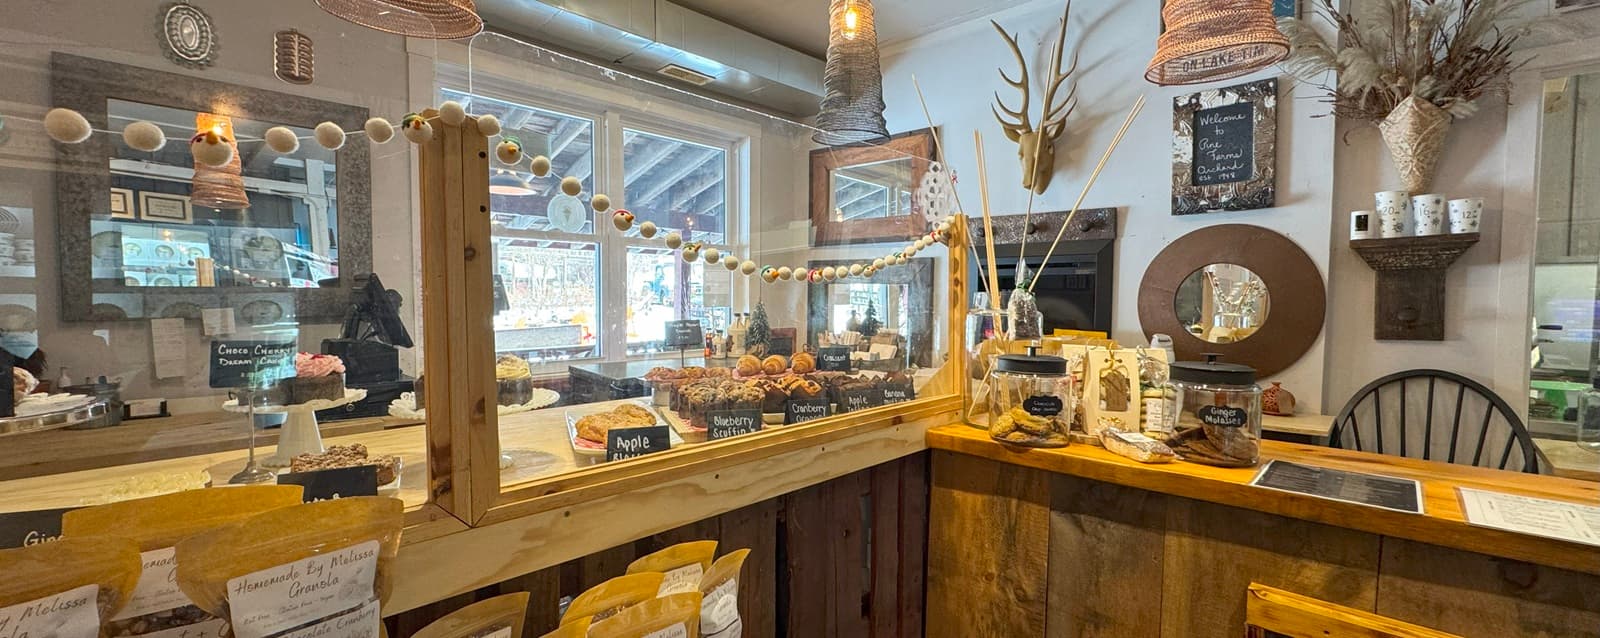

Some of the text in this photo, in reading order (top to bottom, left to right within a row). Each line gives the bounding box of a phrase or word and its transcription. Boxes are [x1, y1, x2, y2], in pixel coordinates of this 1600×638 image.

[1202, 50, 1235, 69] LAKE
[1200, 112, 1247, 126] Welcome
[1215, 125, 1225, 135] to
[1199, 138, 1223, 150] Pine
[1197, 160, 1244, 174] Orchard
[848, 395, 868, 407] Apple
[791, 403, 827, 415] Cranberry
[1211, 407, 1236, 418] Ginger
[713, 415, 754, 428] Blueberry
[616, 435, 650, 451] Apple
[234, 549, 374, 596] Homemade By Melissa
[288, 573, 339, 599] Granola
[20, 597, 87, 622] Melissa
